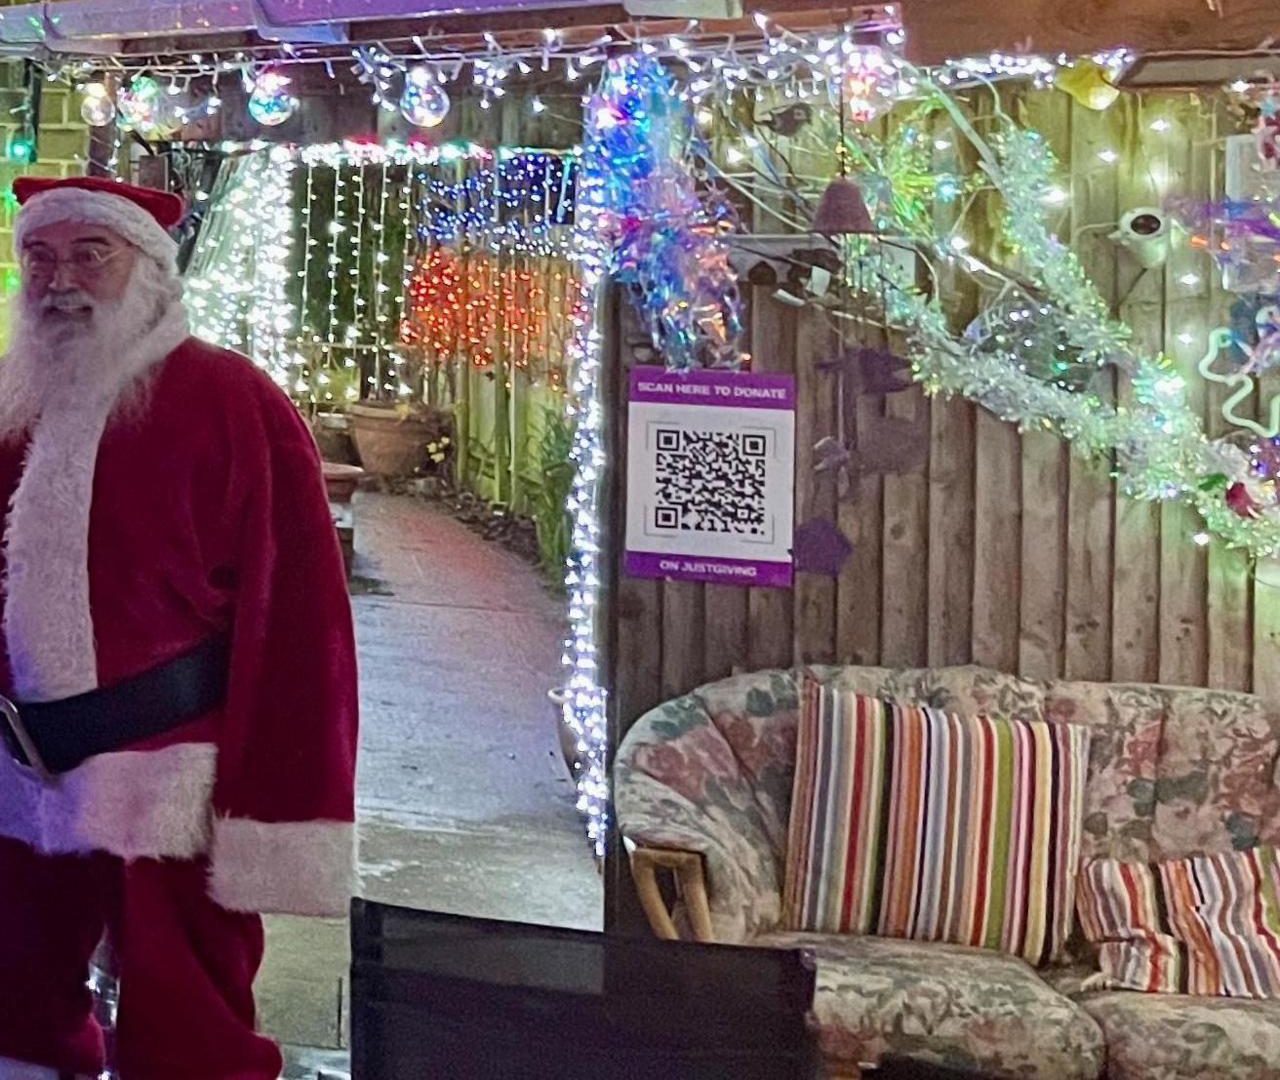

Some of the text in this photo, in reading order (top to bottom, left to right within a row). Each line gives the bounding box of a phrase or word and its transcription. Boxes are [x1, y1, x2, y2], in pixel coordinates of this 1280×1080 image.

[637, 381, 787, 399] SCAN HERE TO DONATE
[659, 559, 757, 577] ON JUSTGIVING
